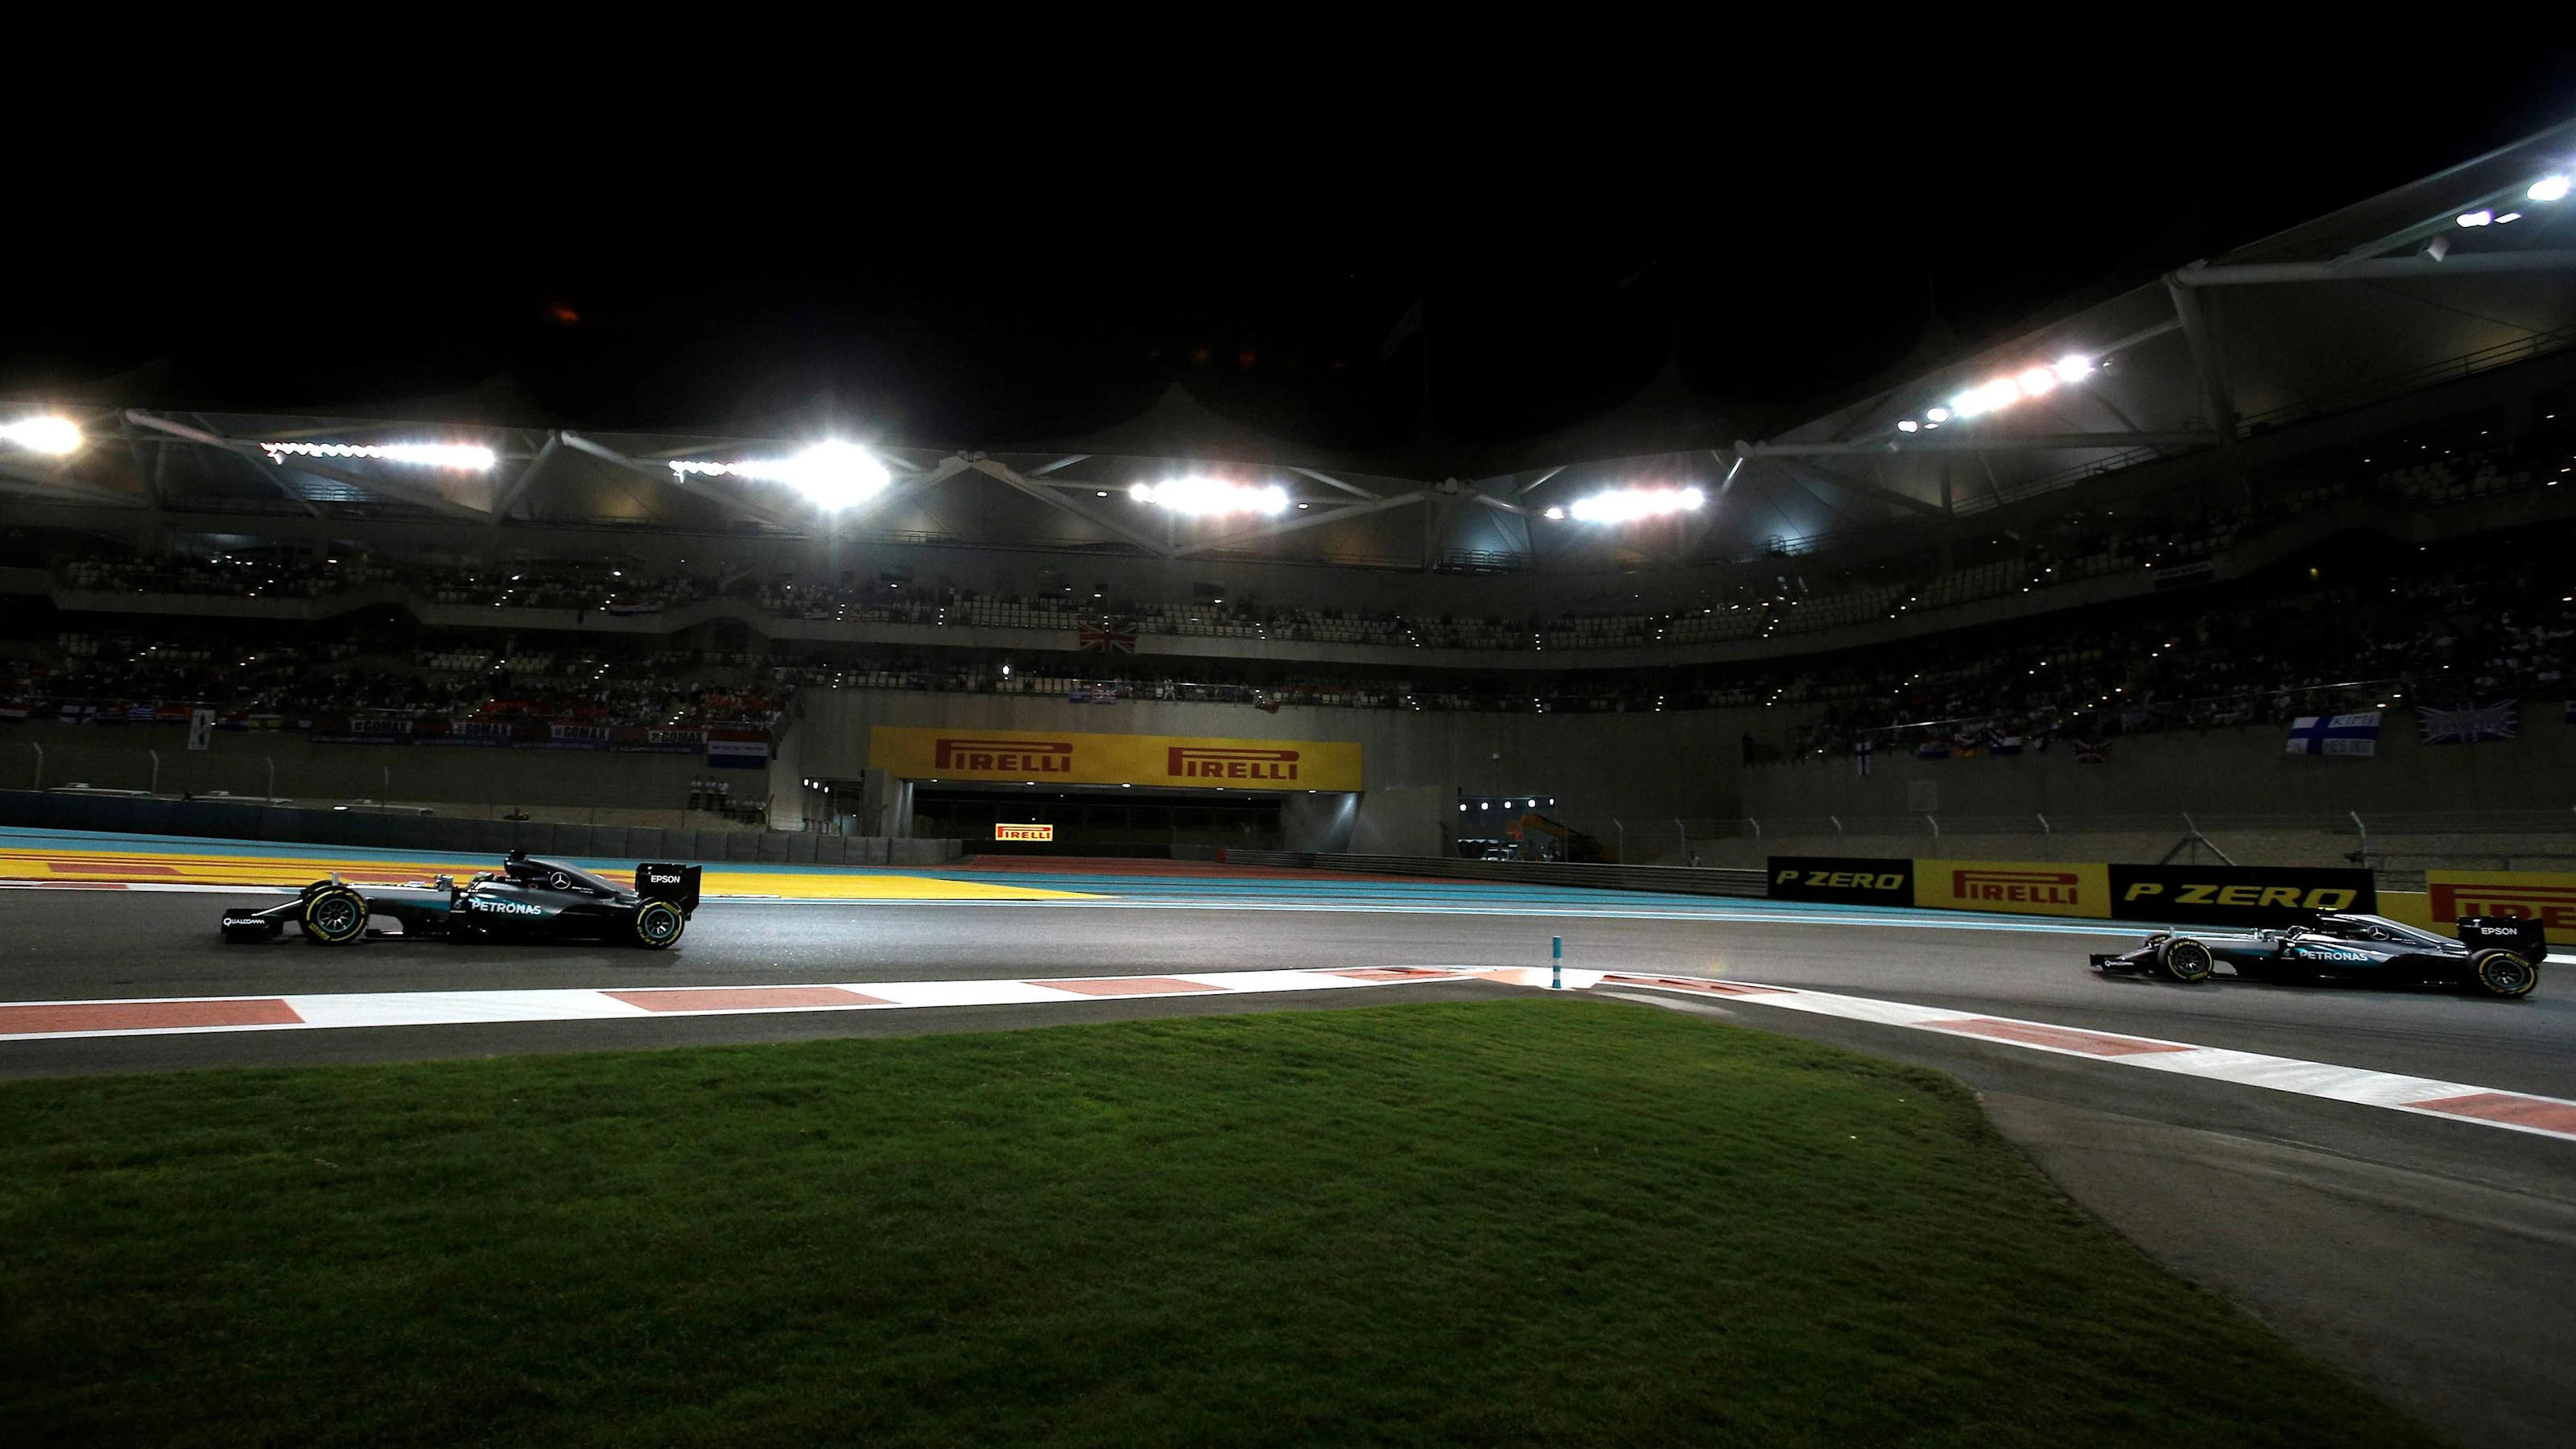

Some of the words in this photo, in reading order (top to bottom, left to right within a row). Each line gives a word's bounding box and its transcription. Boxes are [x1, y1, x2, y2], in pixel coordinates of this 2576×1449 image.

[935, 739, 1073, 772] PIRELLI
[1168, 747, 1299, 780] PIRELLI
[997, 826, 1051, 839] PIRELLI
[650, 874, 681, 884] EPSON
[1776, 870, 1799, 885] P
[1804, 871, 1905, 891] ZERO
[1953, 870, 2079, 905] PIRELLI
[2124, 882, 2164, 902] P
[2174, 884, 2358, 910] ZERO
[471, 900, 542, 915] PETRONAS
[2480, 927, 2518, 935] EPSON
[2299, 951, 2368, 961] PETRONAS
